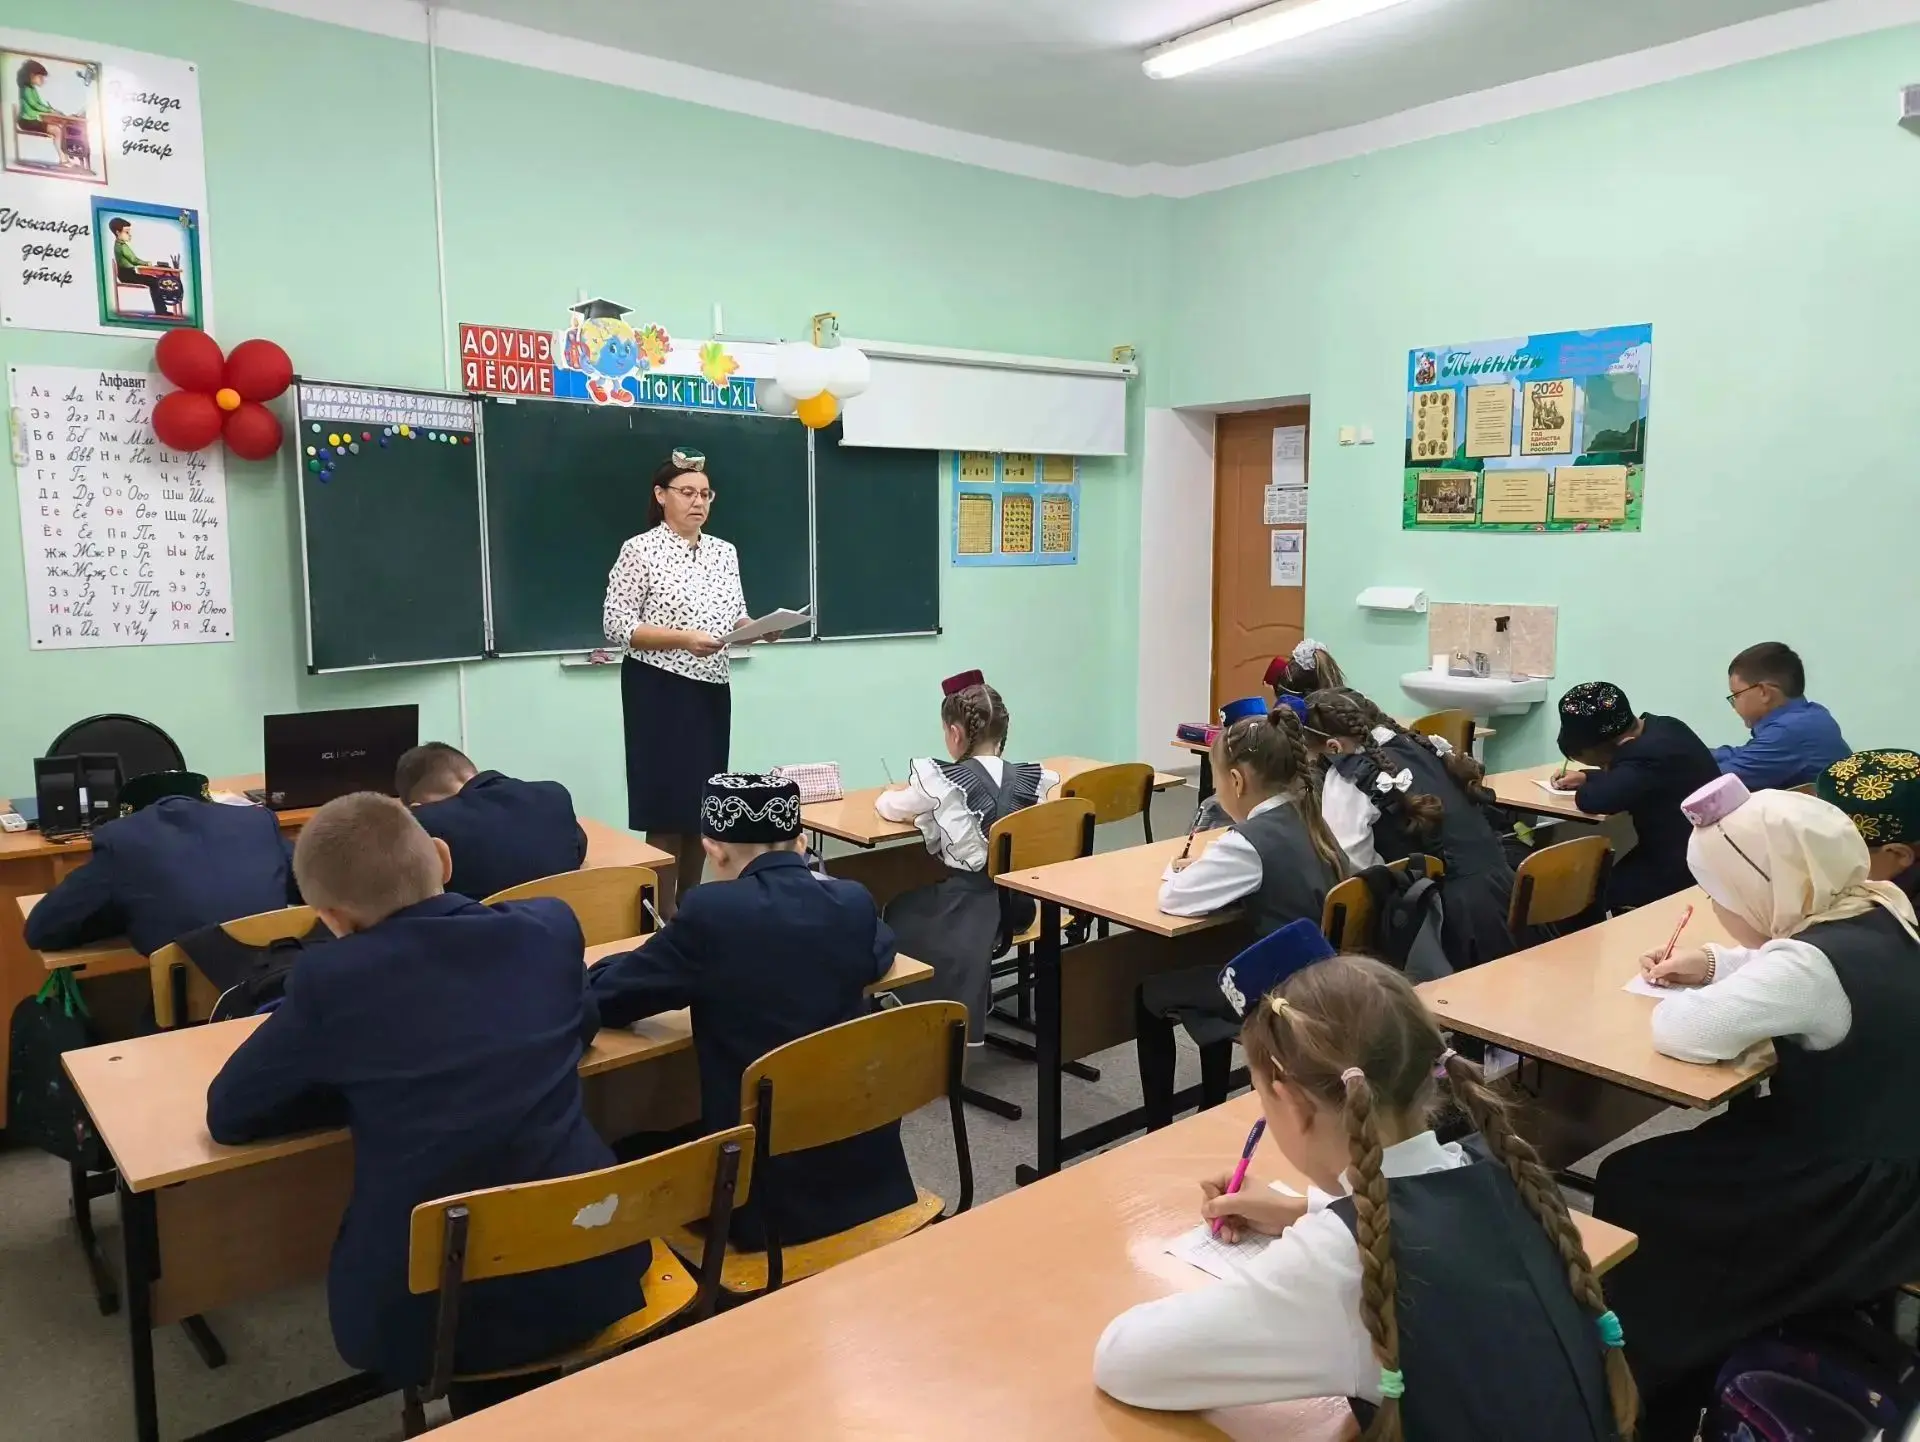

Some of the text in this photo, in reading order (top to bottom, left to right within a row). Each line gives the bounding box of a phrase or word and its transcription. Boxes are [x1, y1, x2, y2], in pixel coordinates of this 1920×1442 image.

[122, 138, 174, 161] утыр
[0, 207, 91, 241] Укыганда
[22, 266, 73, 288] утыр
[99, 371, 146, 391] Алфавит
[1533, 382, 1564, 395] 2026
